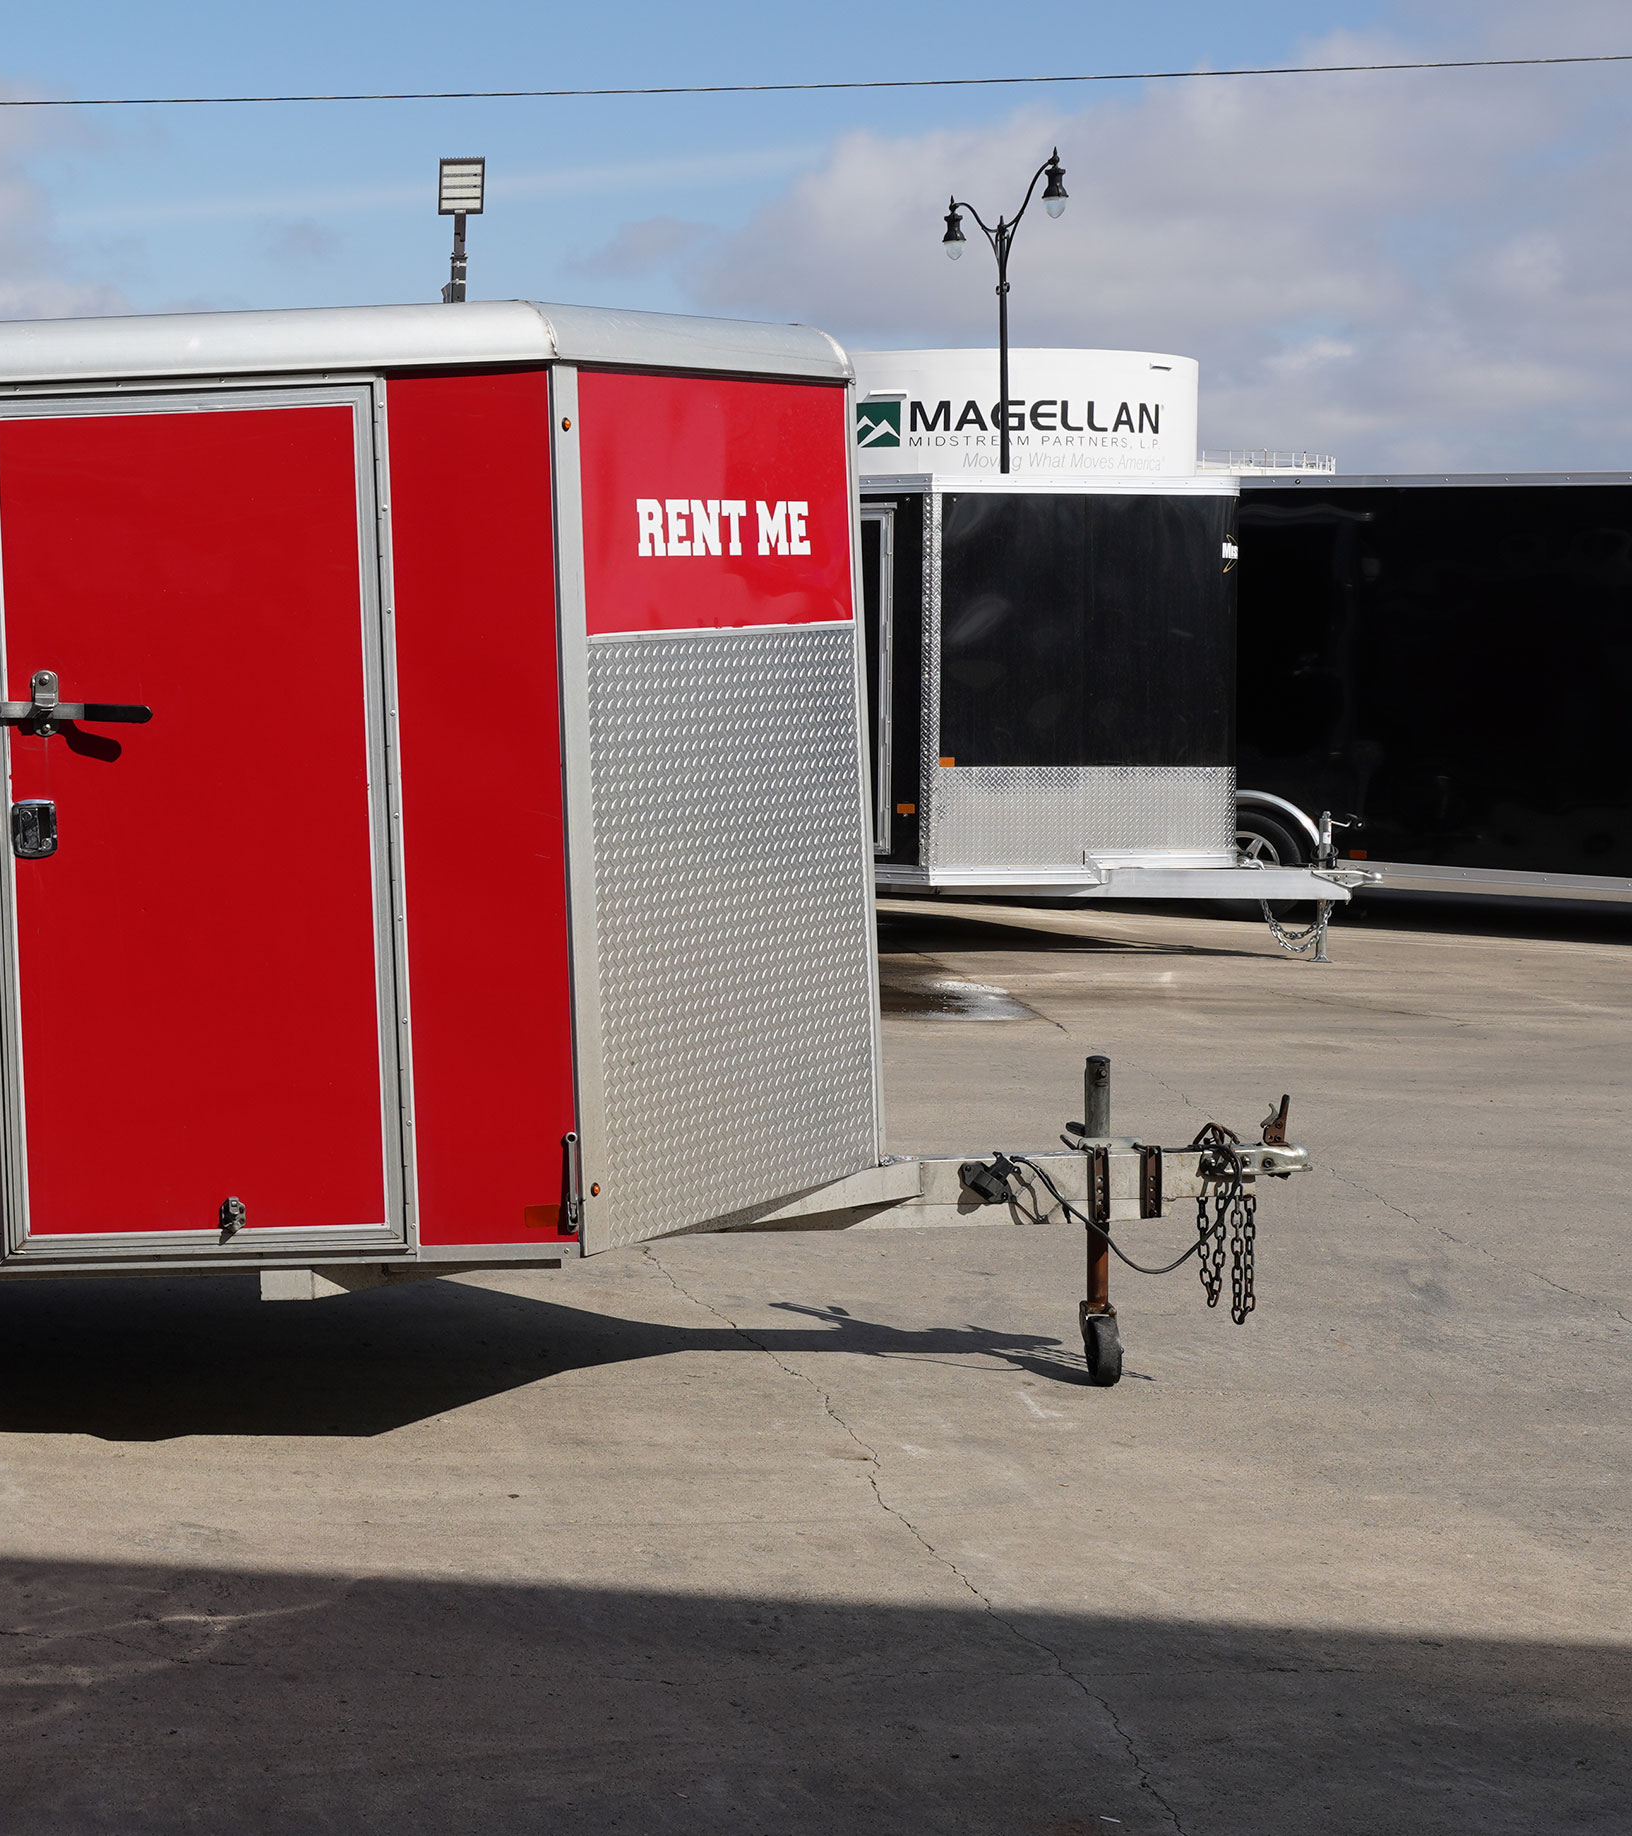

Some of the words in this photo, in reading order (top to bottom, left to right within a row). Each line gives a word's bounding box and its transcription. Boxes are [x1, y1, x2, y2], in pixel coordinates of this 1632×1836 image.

[909, 400, 1160, 434] MAGELLAN
[1028, 452, 1066, 469] What
[1070, 453, 1115, 470] Moves
[1117, 454, 1161, 471] America
[636, 498, 747, 557] RENT
[755, 500, 812, 556] ME
